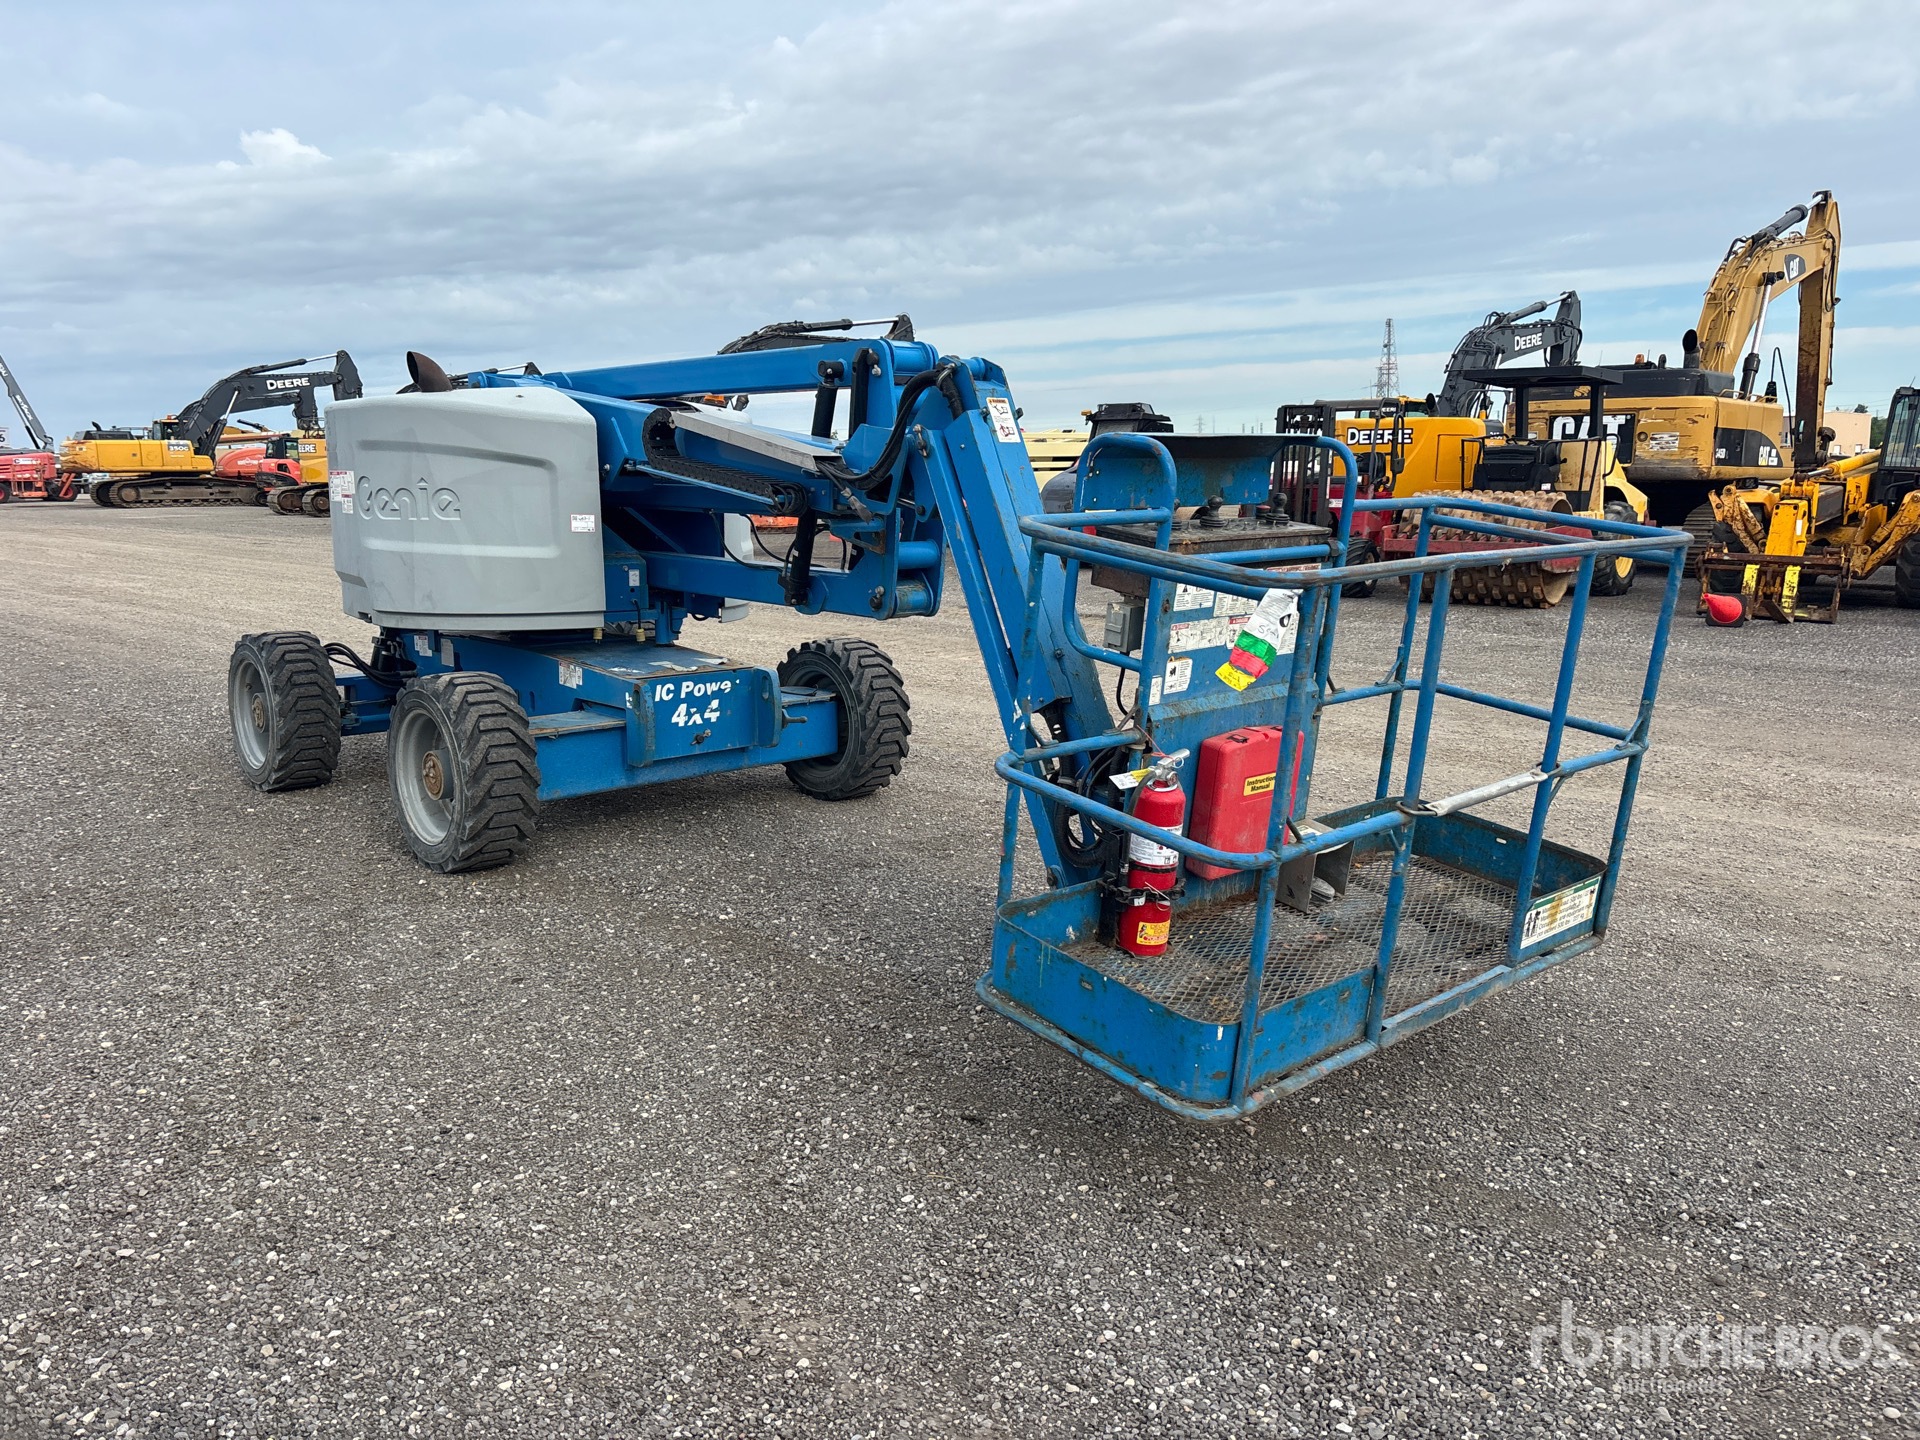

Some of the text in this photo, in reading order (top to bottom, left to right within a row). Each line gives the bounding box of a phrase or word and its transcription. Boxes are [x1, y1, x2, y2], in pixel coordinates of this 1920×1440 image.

[1789, 257, 1800, 280] CAT
[1514, 332, 1543, 352] DEERE
[266, 377, 311, 391] DEERE
[1347, 428, 1413, 445] DEERE
[298, 443, 317, 453] EERE
[1758, 445, 1771, 466] CAT
[357, 475, 461, 521] Genie
[655, 679, 740, 702] IC Powe
[671, 699, 720, 727] 4x4
[1246, 775, 1276, 787] Instruction
[1251, 782, 1271, 792] Manual
